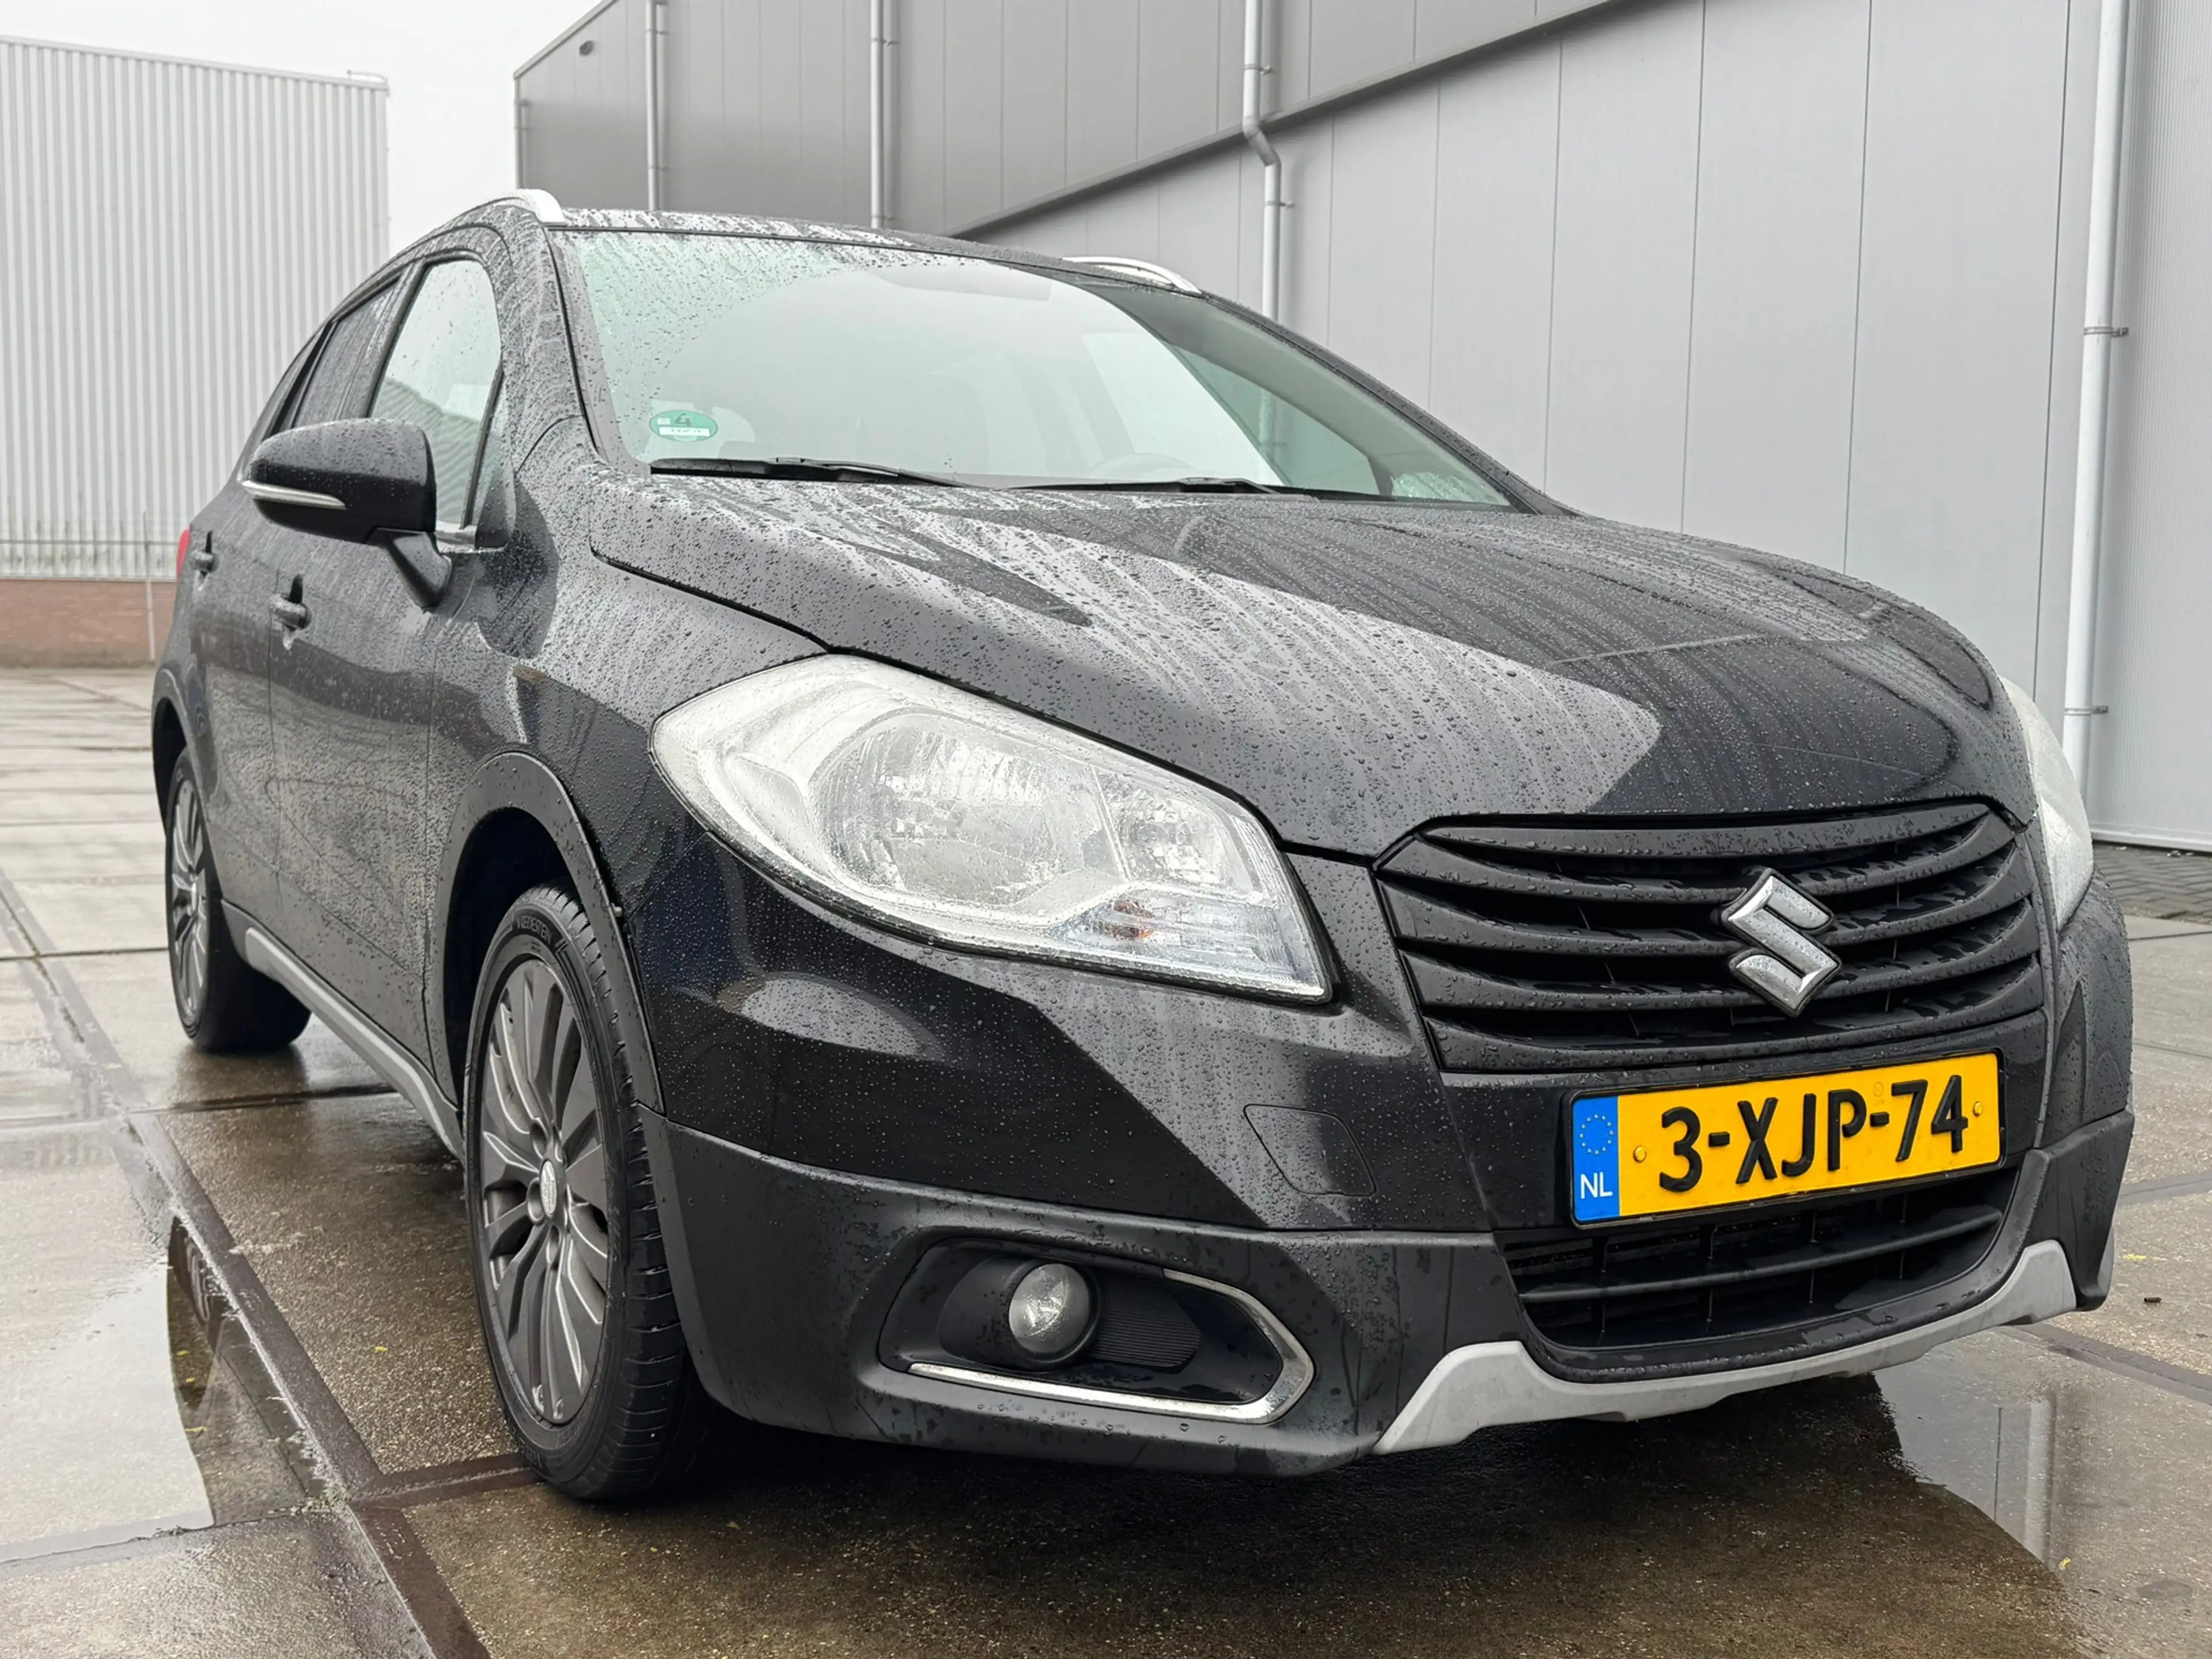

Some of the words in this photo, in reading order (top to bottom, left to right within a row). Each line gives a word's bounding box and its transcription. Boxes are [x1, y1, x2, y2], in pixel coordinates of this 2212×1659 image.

[675, 412, 692, 427] 4
[1659, 1074, 1969, 1193] 3-XJP-74
[1580, 1171, 1613, 1199] NL
